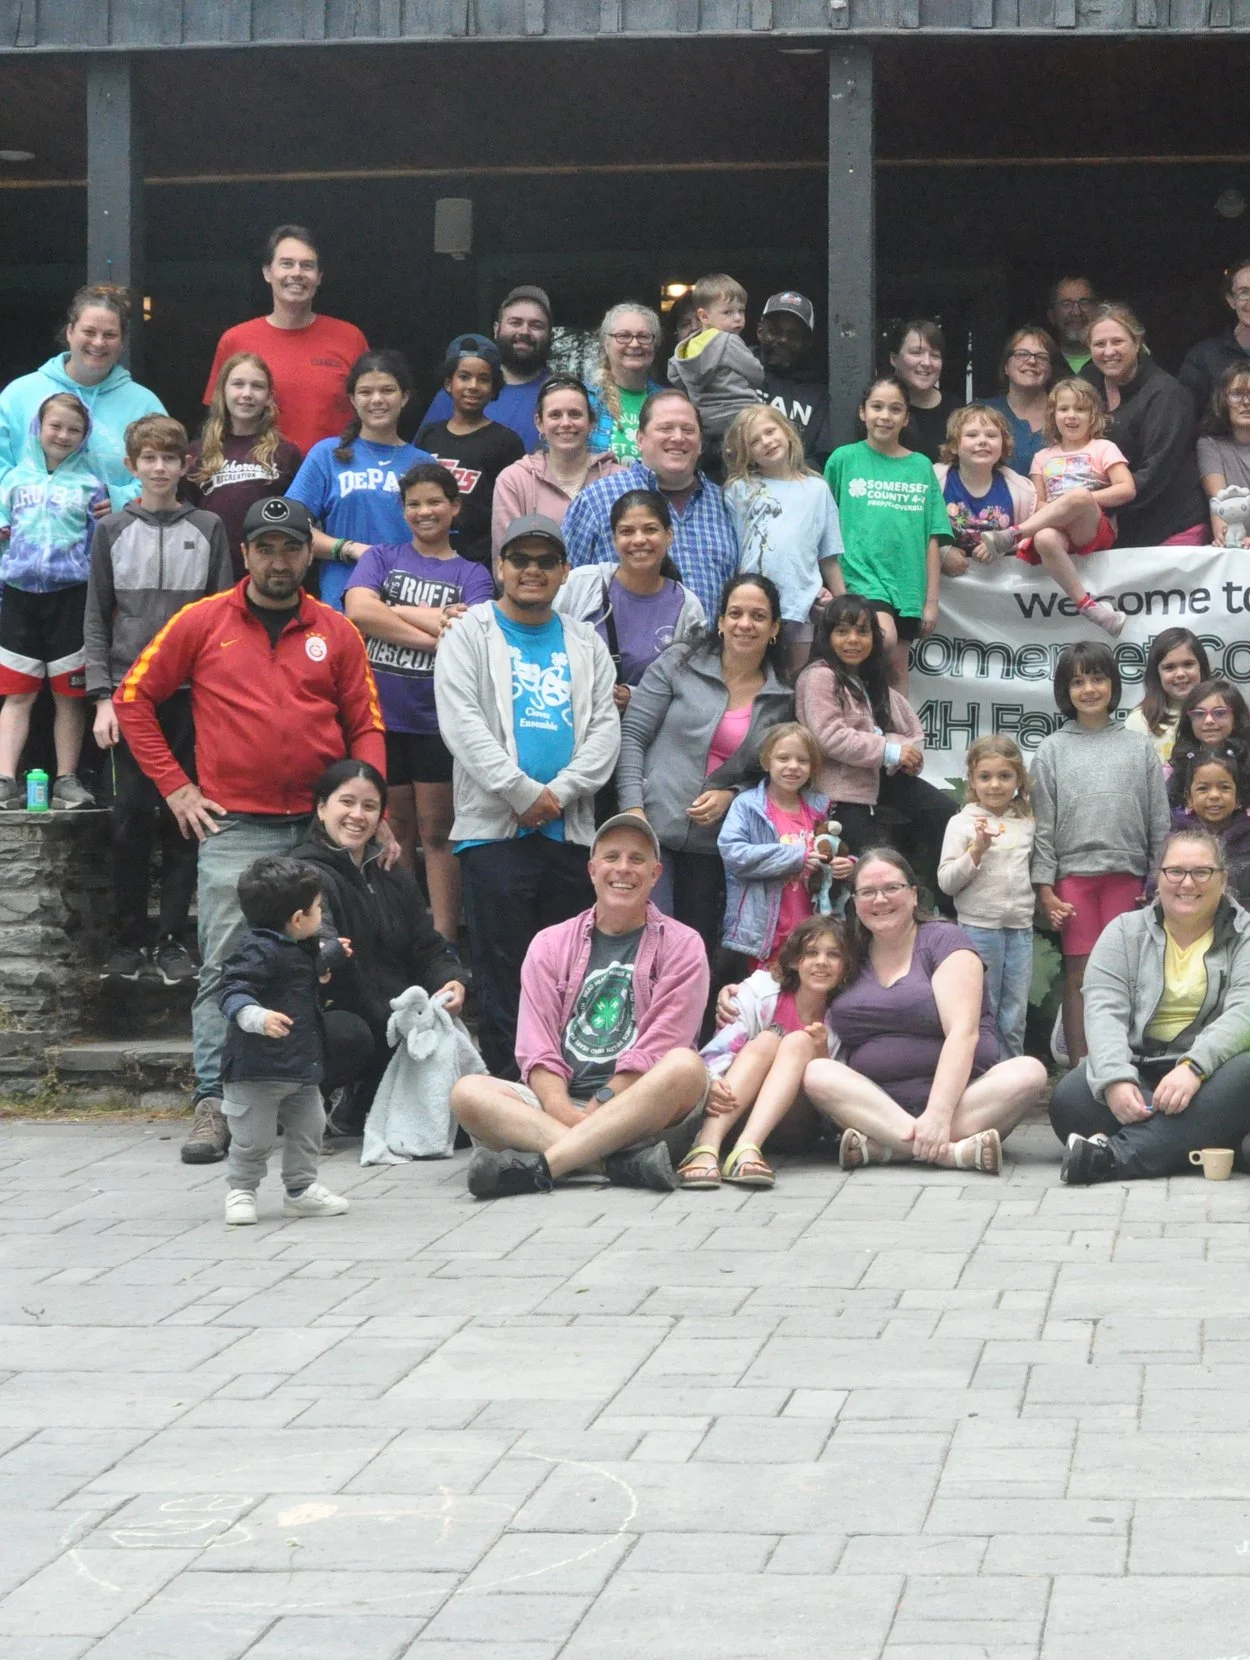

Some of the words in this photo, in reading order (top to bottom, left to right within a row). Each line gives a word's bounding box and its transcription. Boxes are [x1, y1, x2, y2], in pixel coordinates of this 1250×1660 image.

[867, 479, 929, 493] SOMERSET
[867, 490, 909, 502] COUNTY
[525, 706, 551, 719] Clover
[520, 718, 558, 731] Ensemble
[917, 699, 981, 750] 4H
